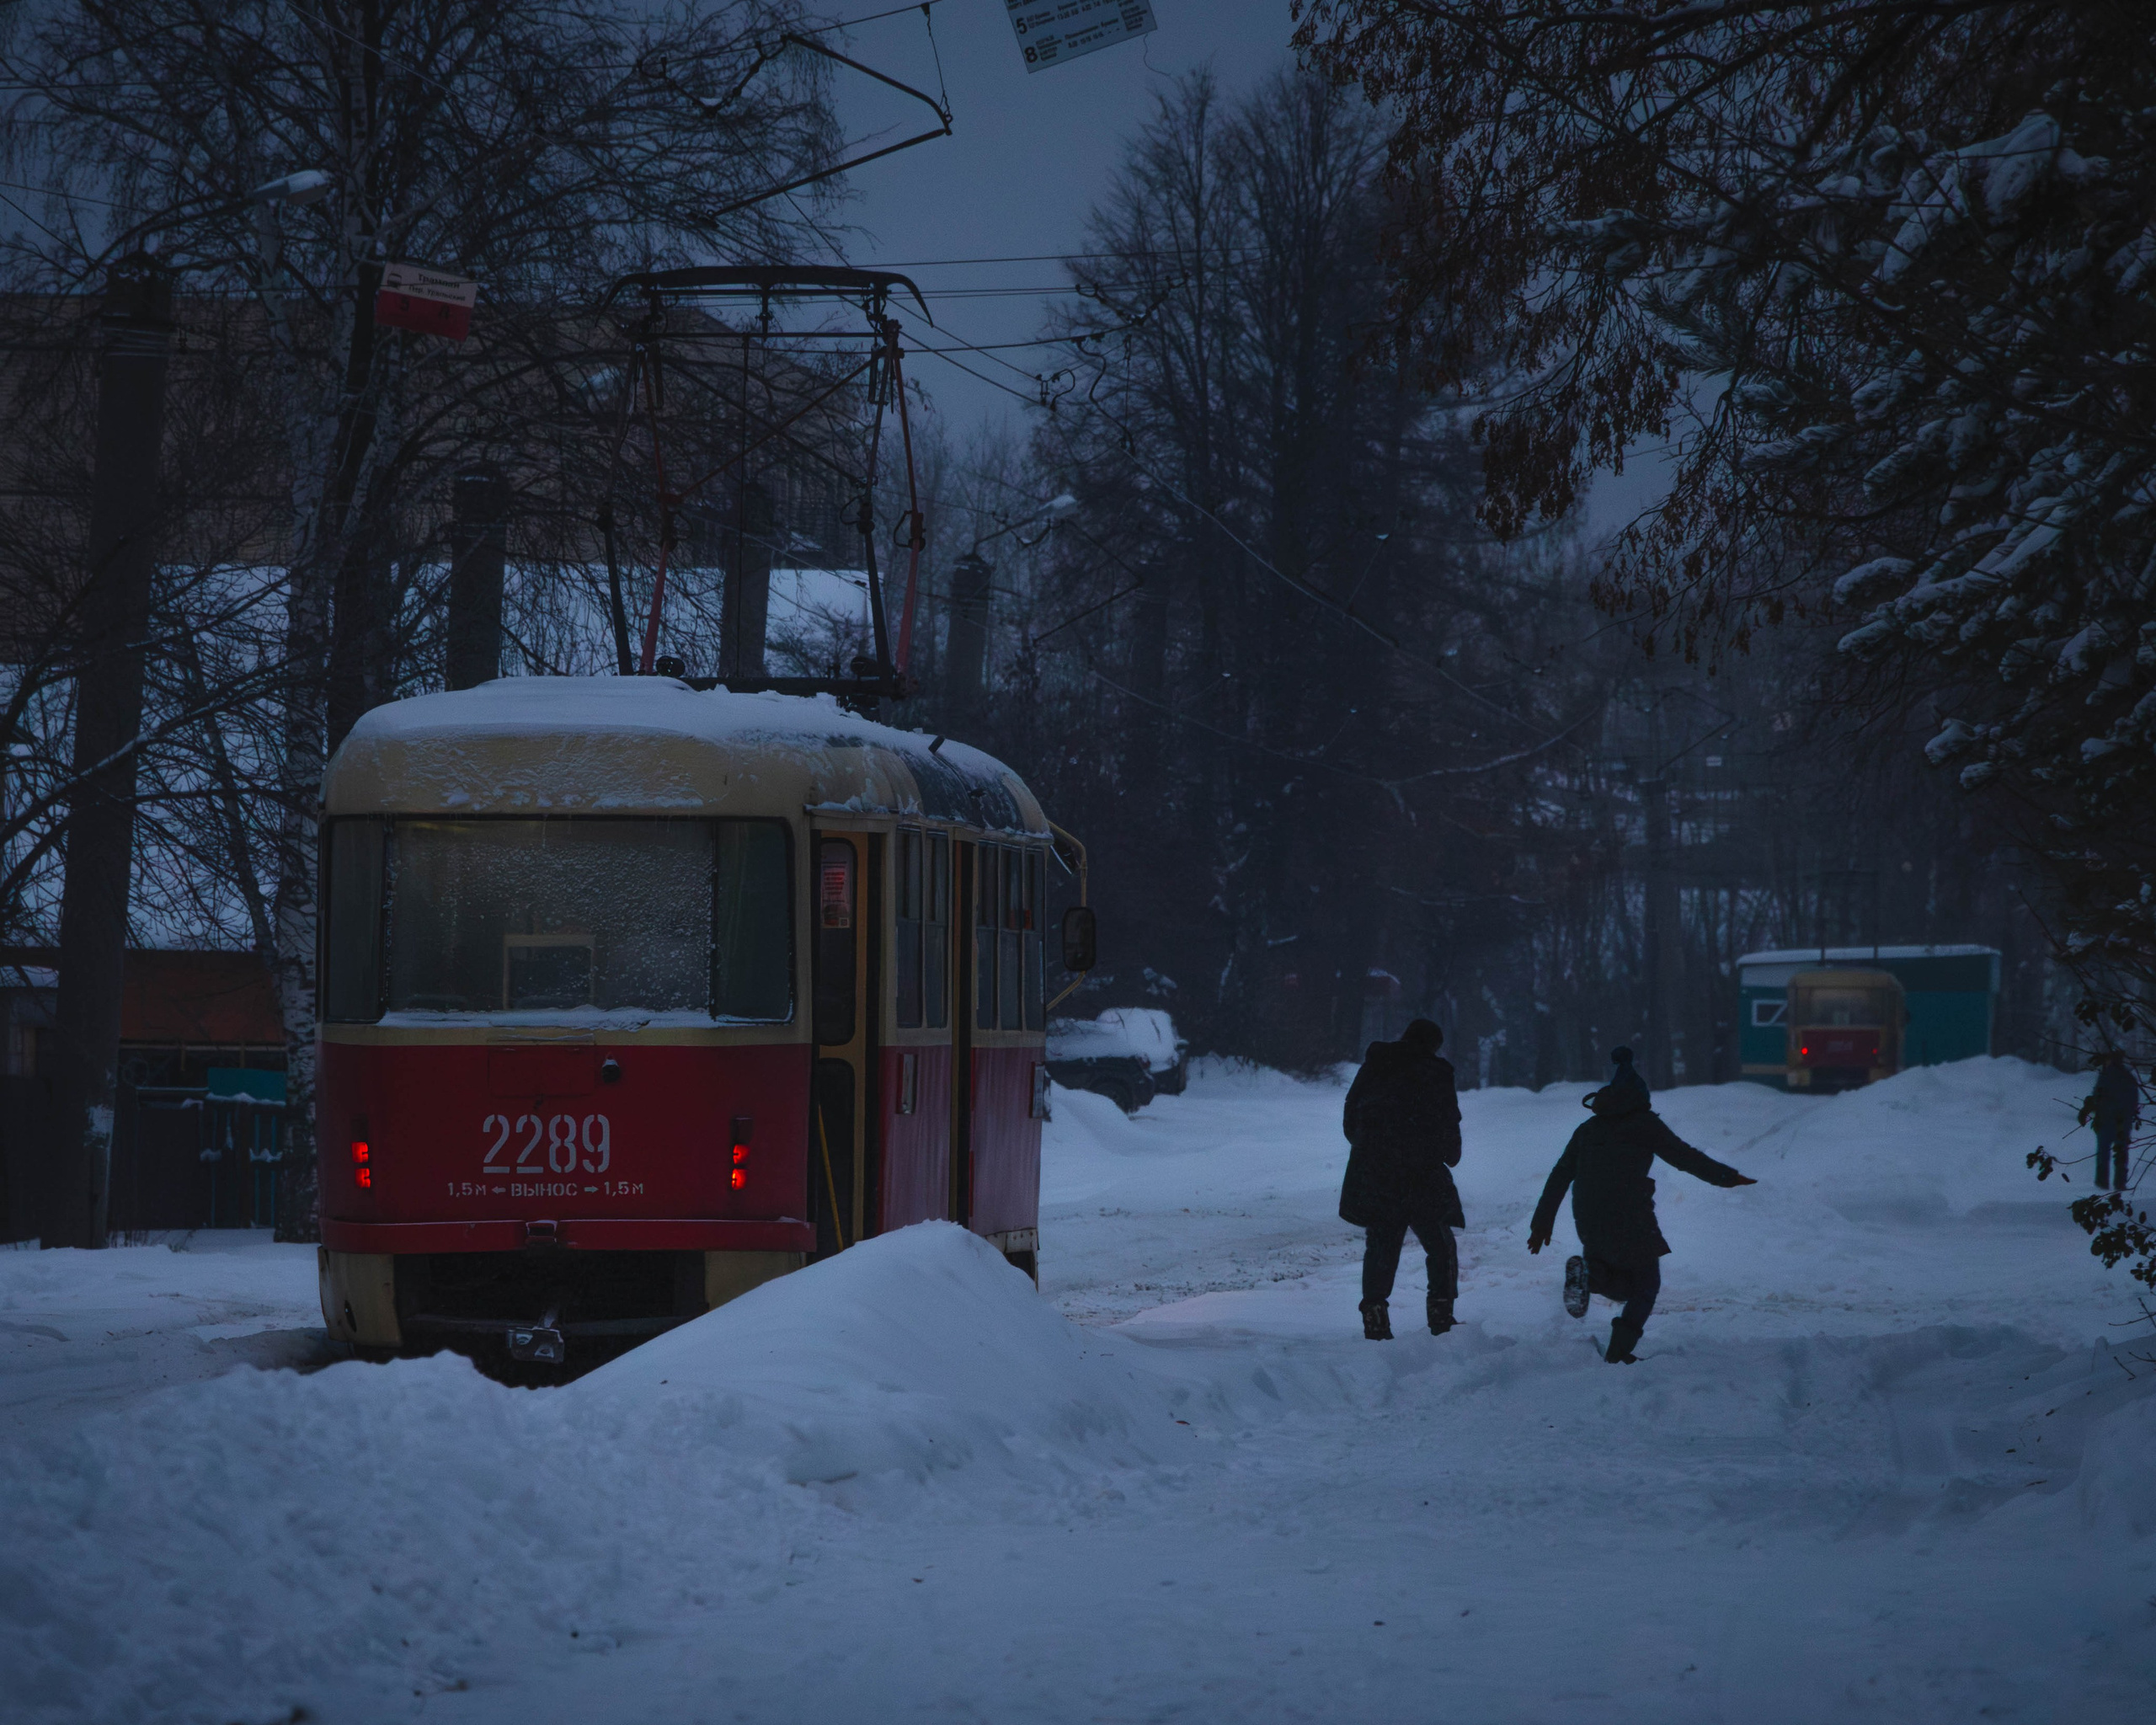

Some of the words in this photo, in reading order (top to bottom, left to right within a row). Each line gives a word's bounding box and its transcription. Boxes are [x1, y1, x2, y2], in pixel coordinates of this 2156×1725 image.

[1016, 17, 1027, 35] 5
[1024, 46, 1038, 63] 8
[483, 1114, 611, 1174] 2289
[510, 1183, 579, 1197] ВЫНОС
